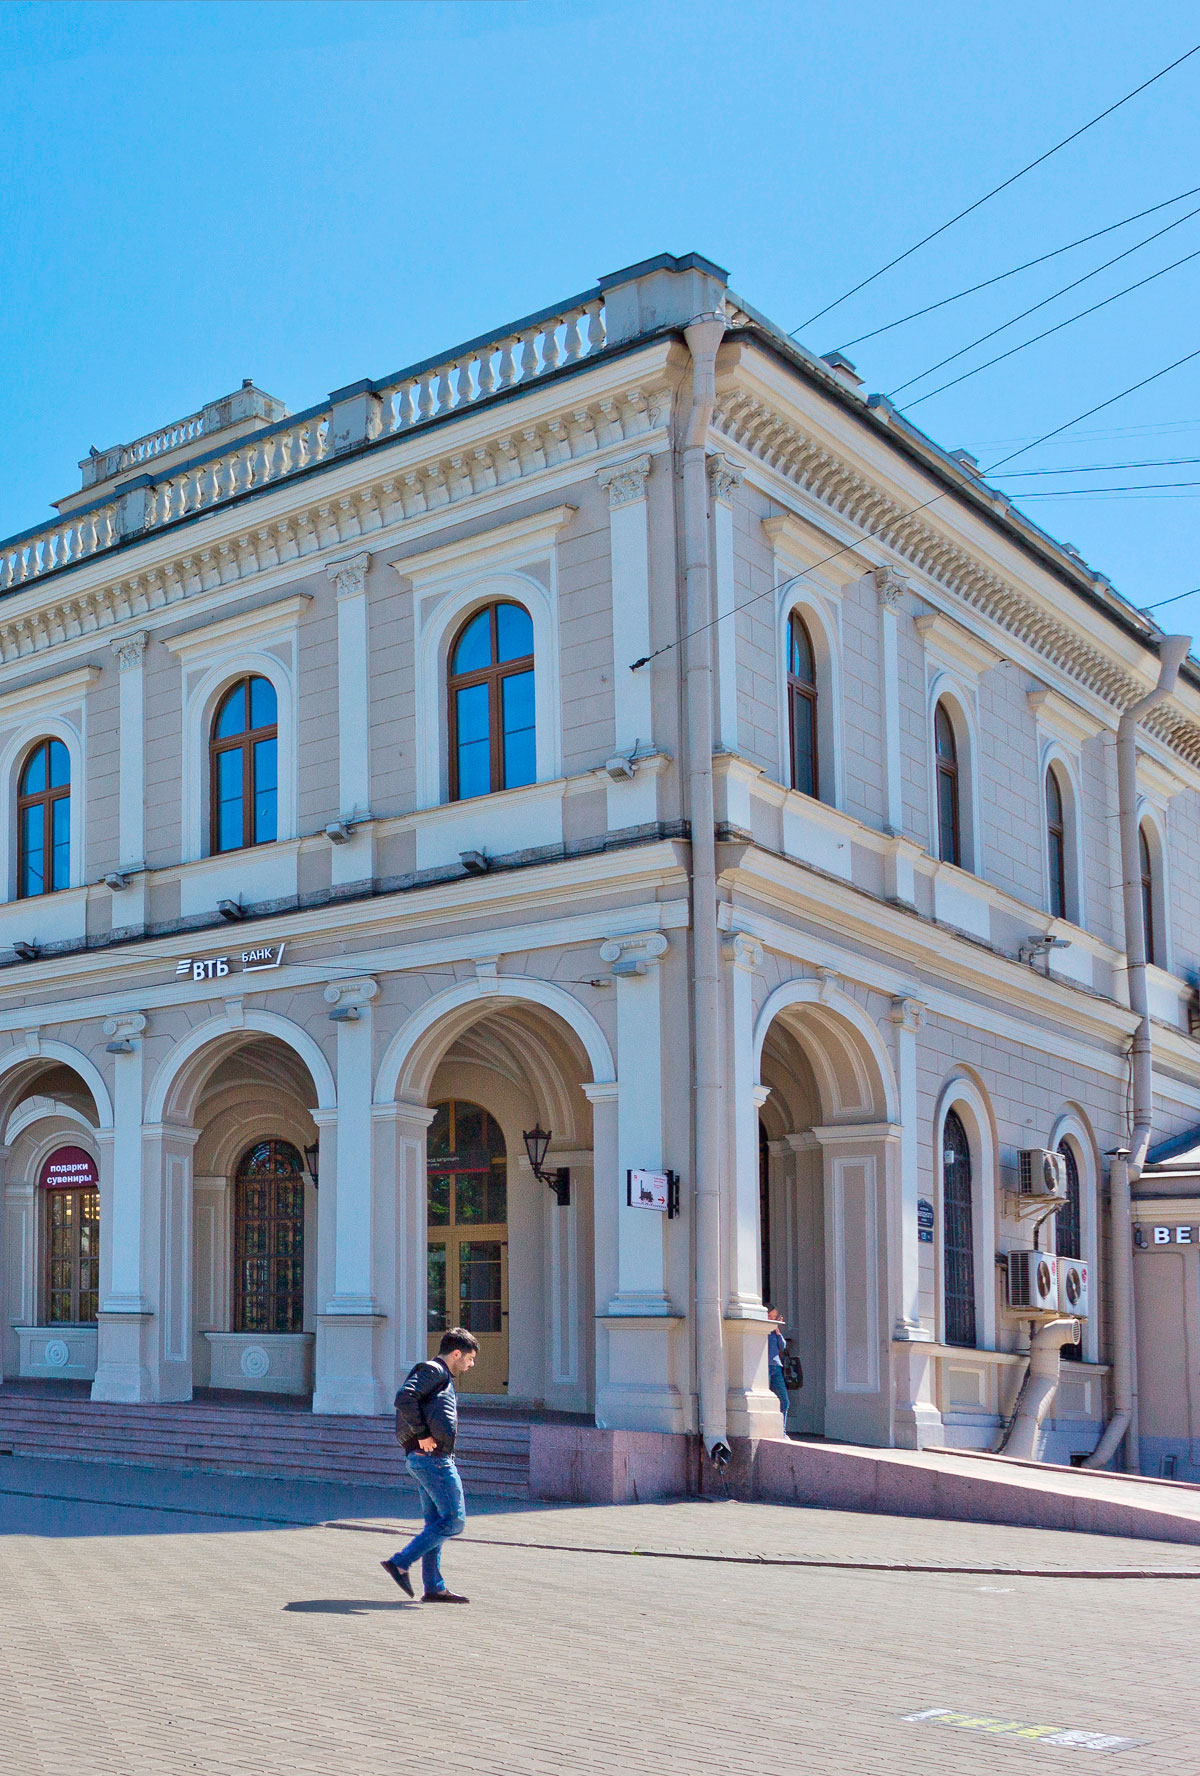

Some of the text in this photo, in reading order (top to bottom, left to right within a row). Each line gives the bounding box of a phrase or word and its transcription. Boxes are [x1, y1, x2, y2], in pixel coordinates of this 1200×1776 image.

[193, 947, 272, 980] ВТБ БАНК
[50, 1163, 88, 1173] подарки
[46, 1174, 92, 1185] сувениры
